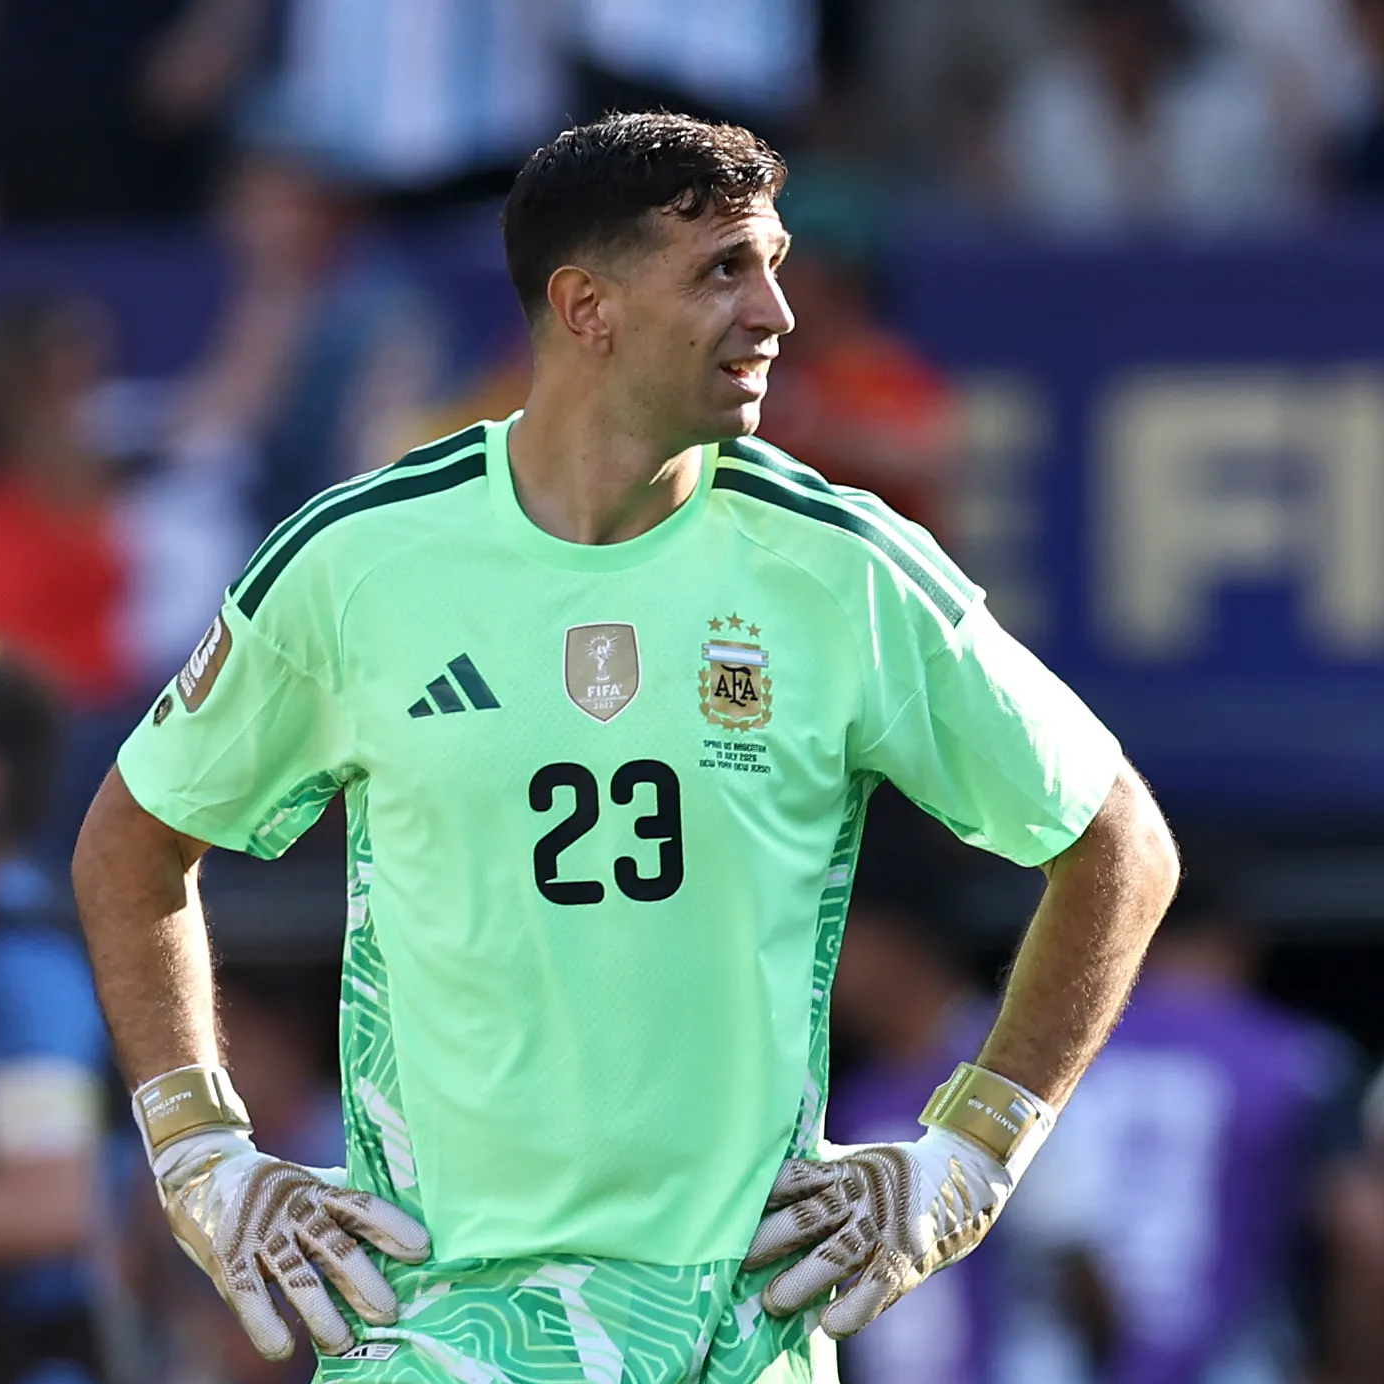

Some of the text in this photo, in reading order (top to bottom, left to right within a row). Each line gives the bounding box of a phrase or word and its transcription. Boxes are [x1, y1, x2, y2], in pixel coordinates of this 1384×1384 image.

[587, 684, 620, 697] FIFA
[714, 664, 758, 706] AFA
[529, 759, 684, 905] 23
